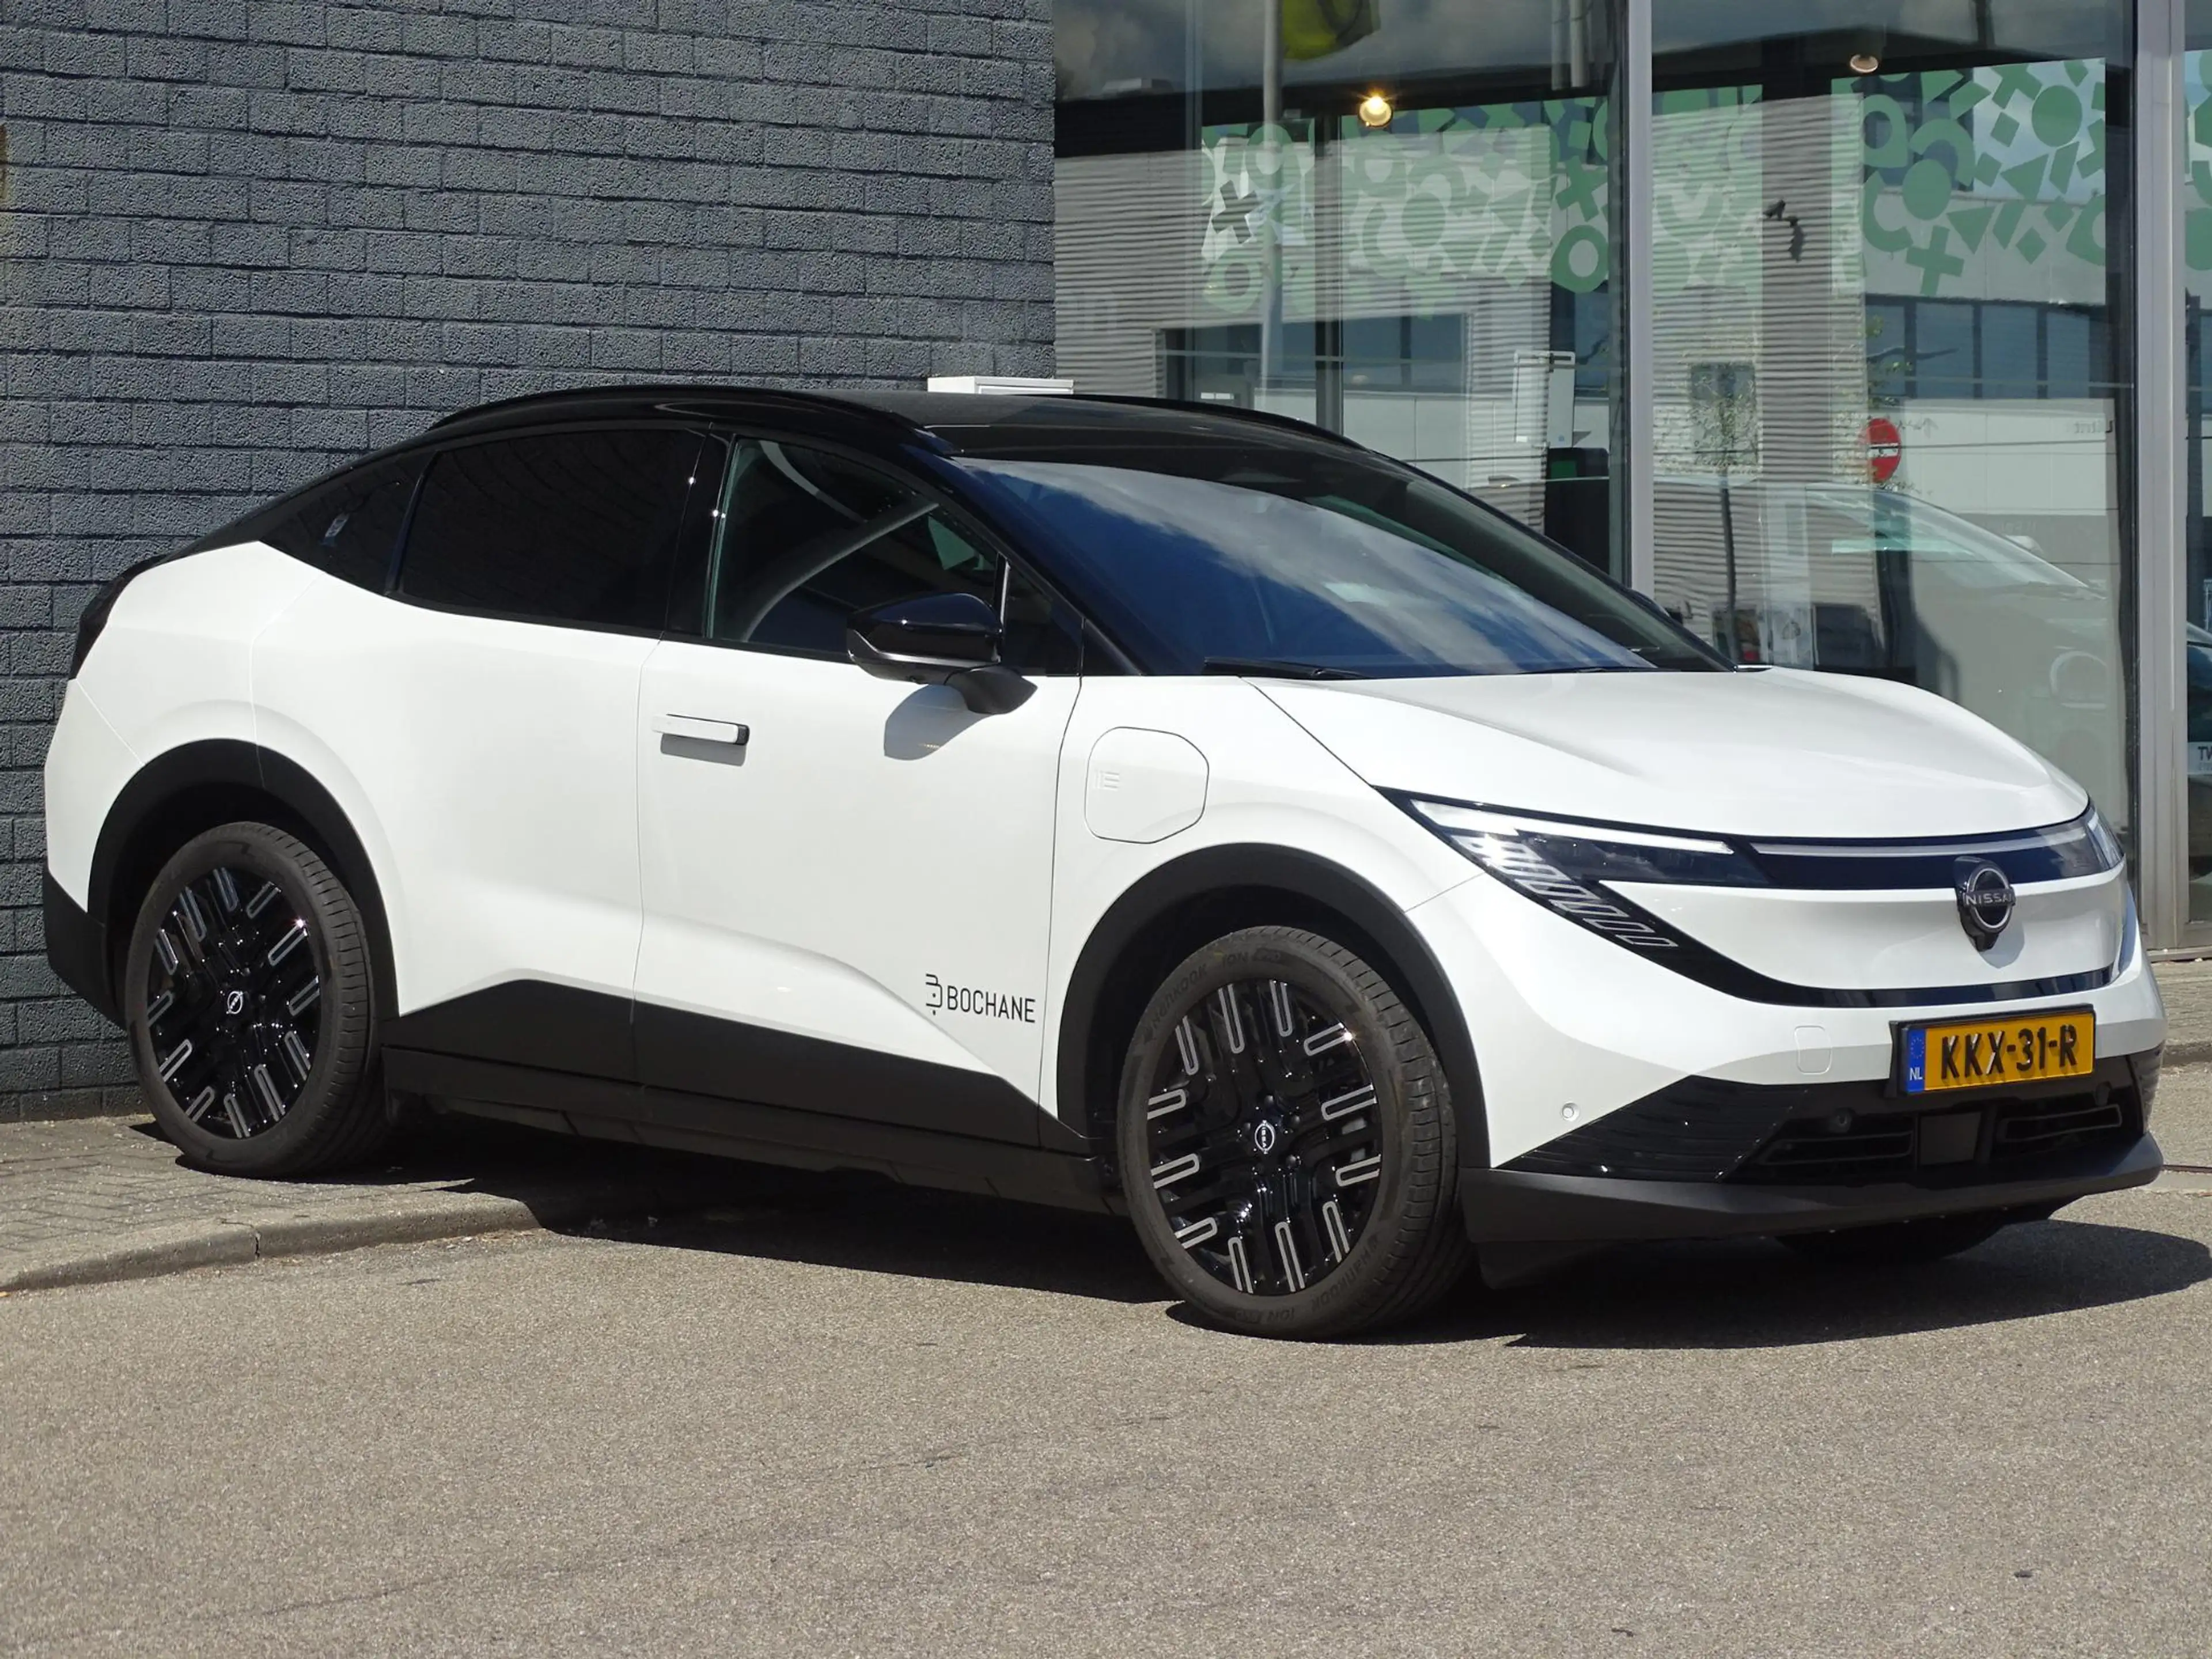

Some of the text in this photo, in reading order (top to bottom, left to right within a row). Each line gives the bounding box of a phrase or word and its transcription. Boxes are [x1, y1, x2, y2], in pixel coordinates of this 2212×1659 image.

[947, 985, 1035, 1024] BOCHANE
[1941, 1024, 2078, 1080] KKX-31-R
[1909, 1067, 1923, 1081] NL
